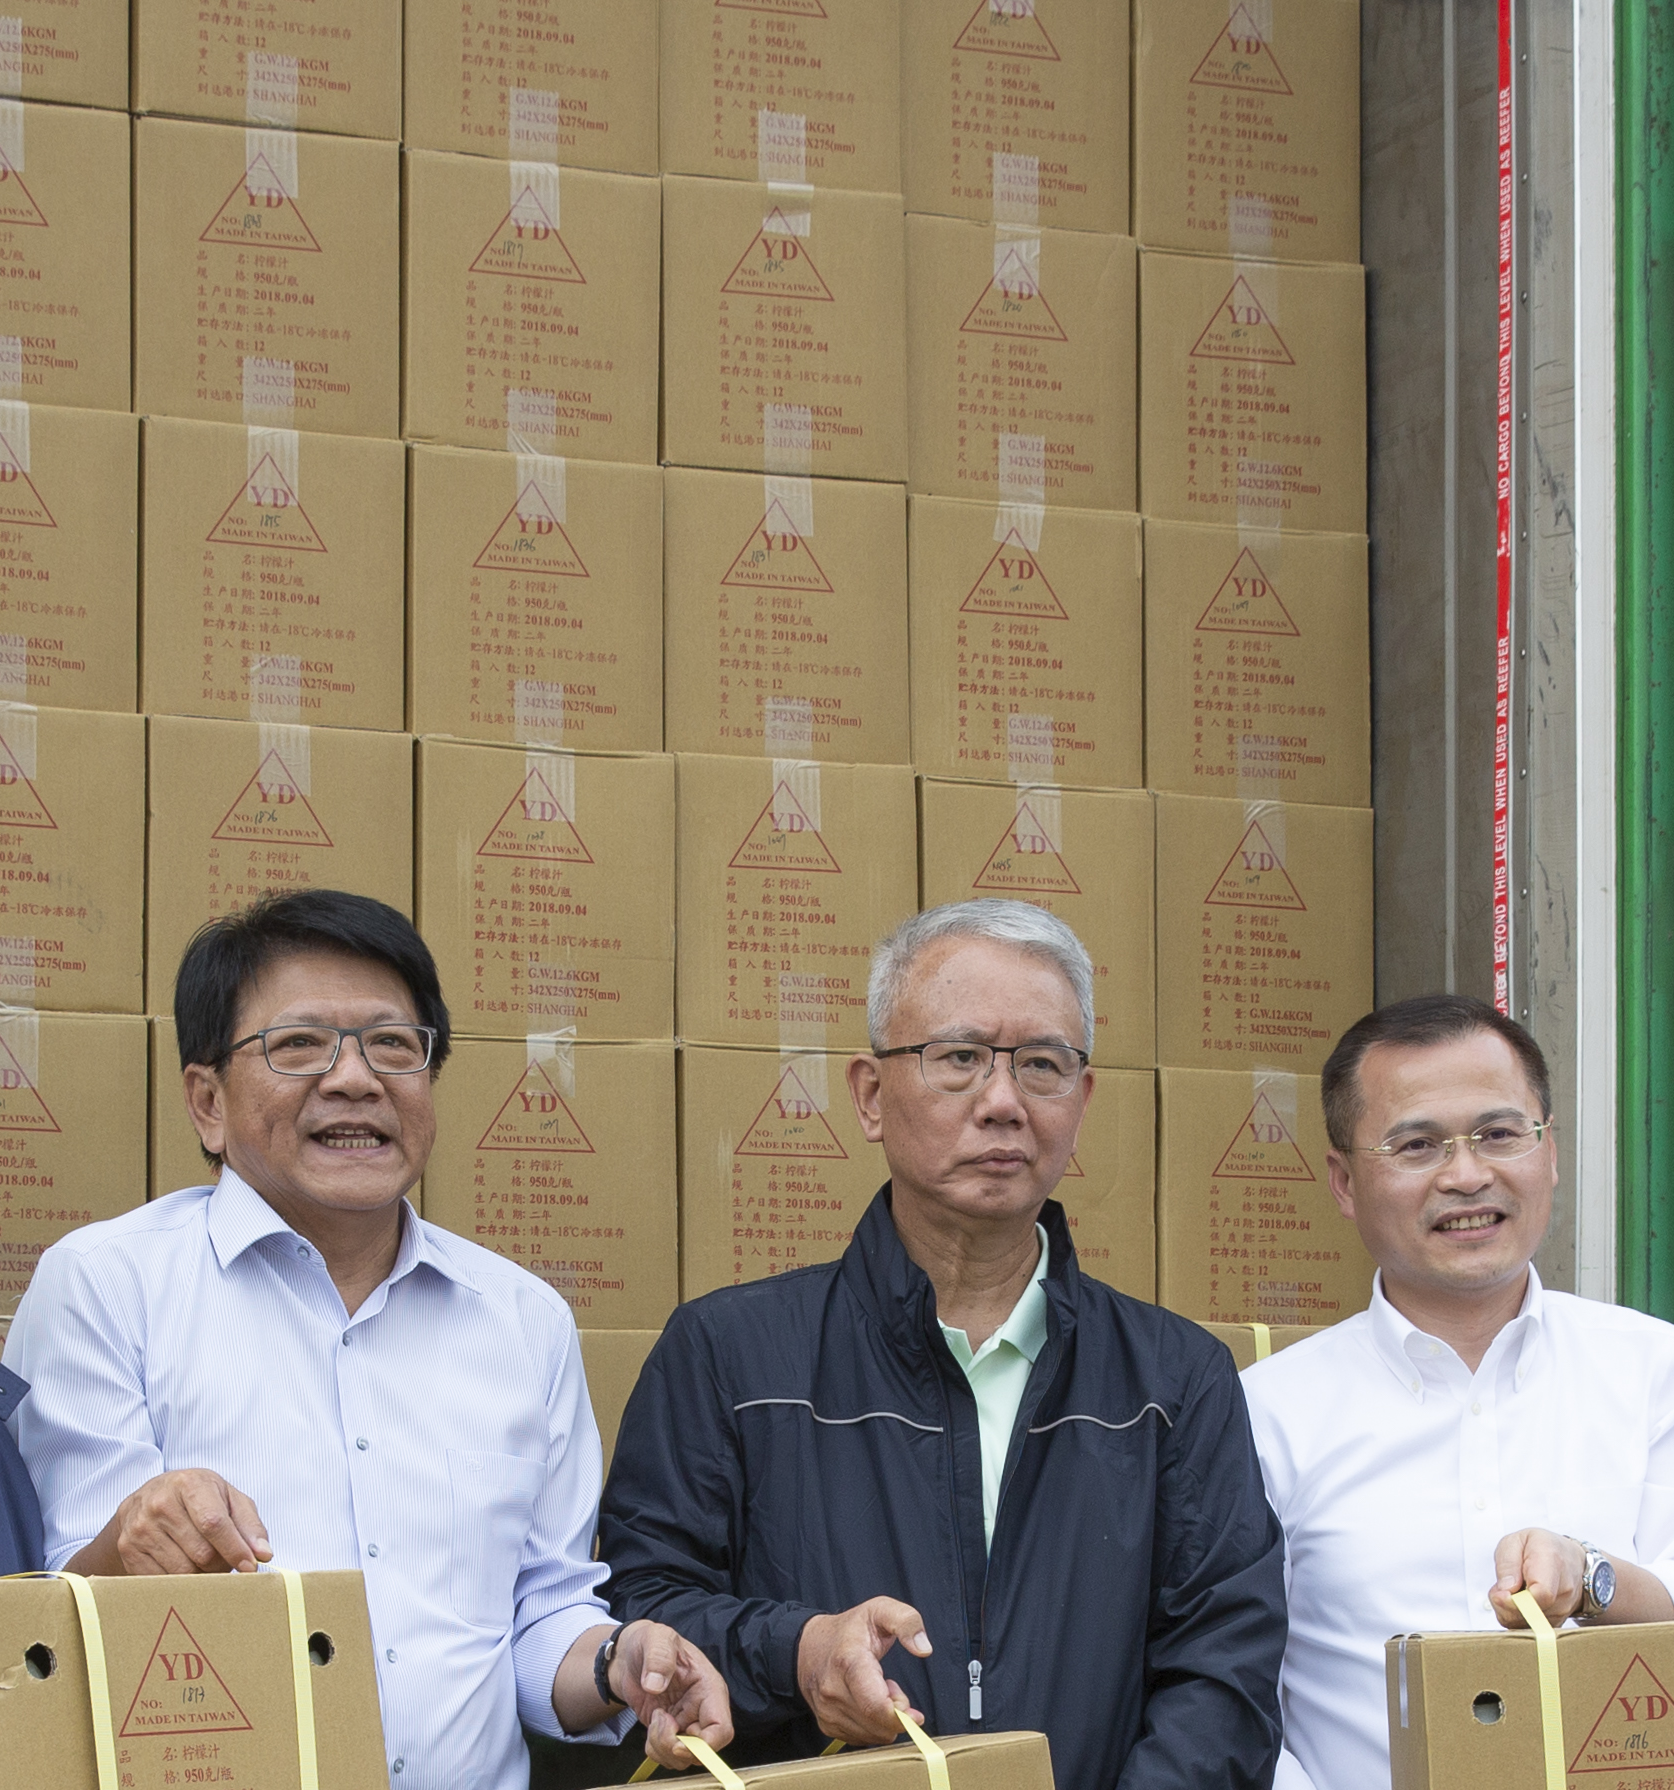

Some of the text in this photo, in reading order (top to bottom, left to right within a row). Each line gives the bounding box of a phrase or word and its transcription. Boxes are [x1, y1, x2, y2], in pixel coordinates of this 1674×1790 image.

[511, 217, 550, 241] YD
[1499, 86, 1511, 500] NO CARGO BEYOND THIS LEVEL WHEN USED AS REEFER
[521, 319, 581, 337] 2018.09.04
[250, 485, 290, 509] YD
[515, 512, 554, 536] YD
[998, 558, 1034, 580] YD
[1232, 577, 1267, 598] YD
[525, 614, 585, 630] 2018.09.04
[1009, 655, 1065, 670] 2018.09.04
[1498, 636, 1509, 694] REEFER
[1496, 723, 1507, 764] USED
[1495, 768, 1507, 812] WHEN
[1495, 814, 1506, 862] LEVEL
[1495, 866, 1506, 899] THIS
[159, 1652, 204, 1682] YD
[134, 1710, 235, 1726] MADE IN TAIWAN
[1618, 1695, 1668, 1722] YD
[1586, 1751, 1626, 1763] MADE
[1629, 1750, 1645, 1760] IN
